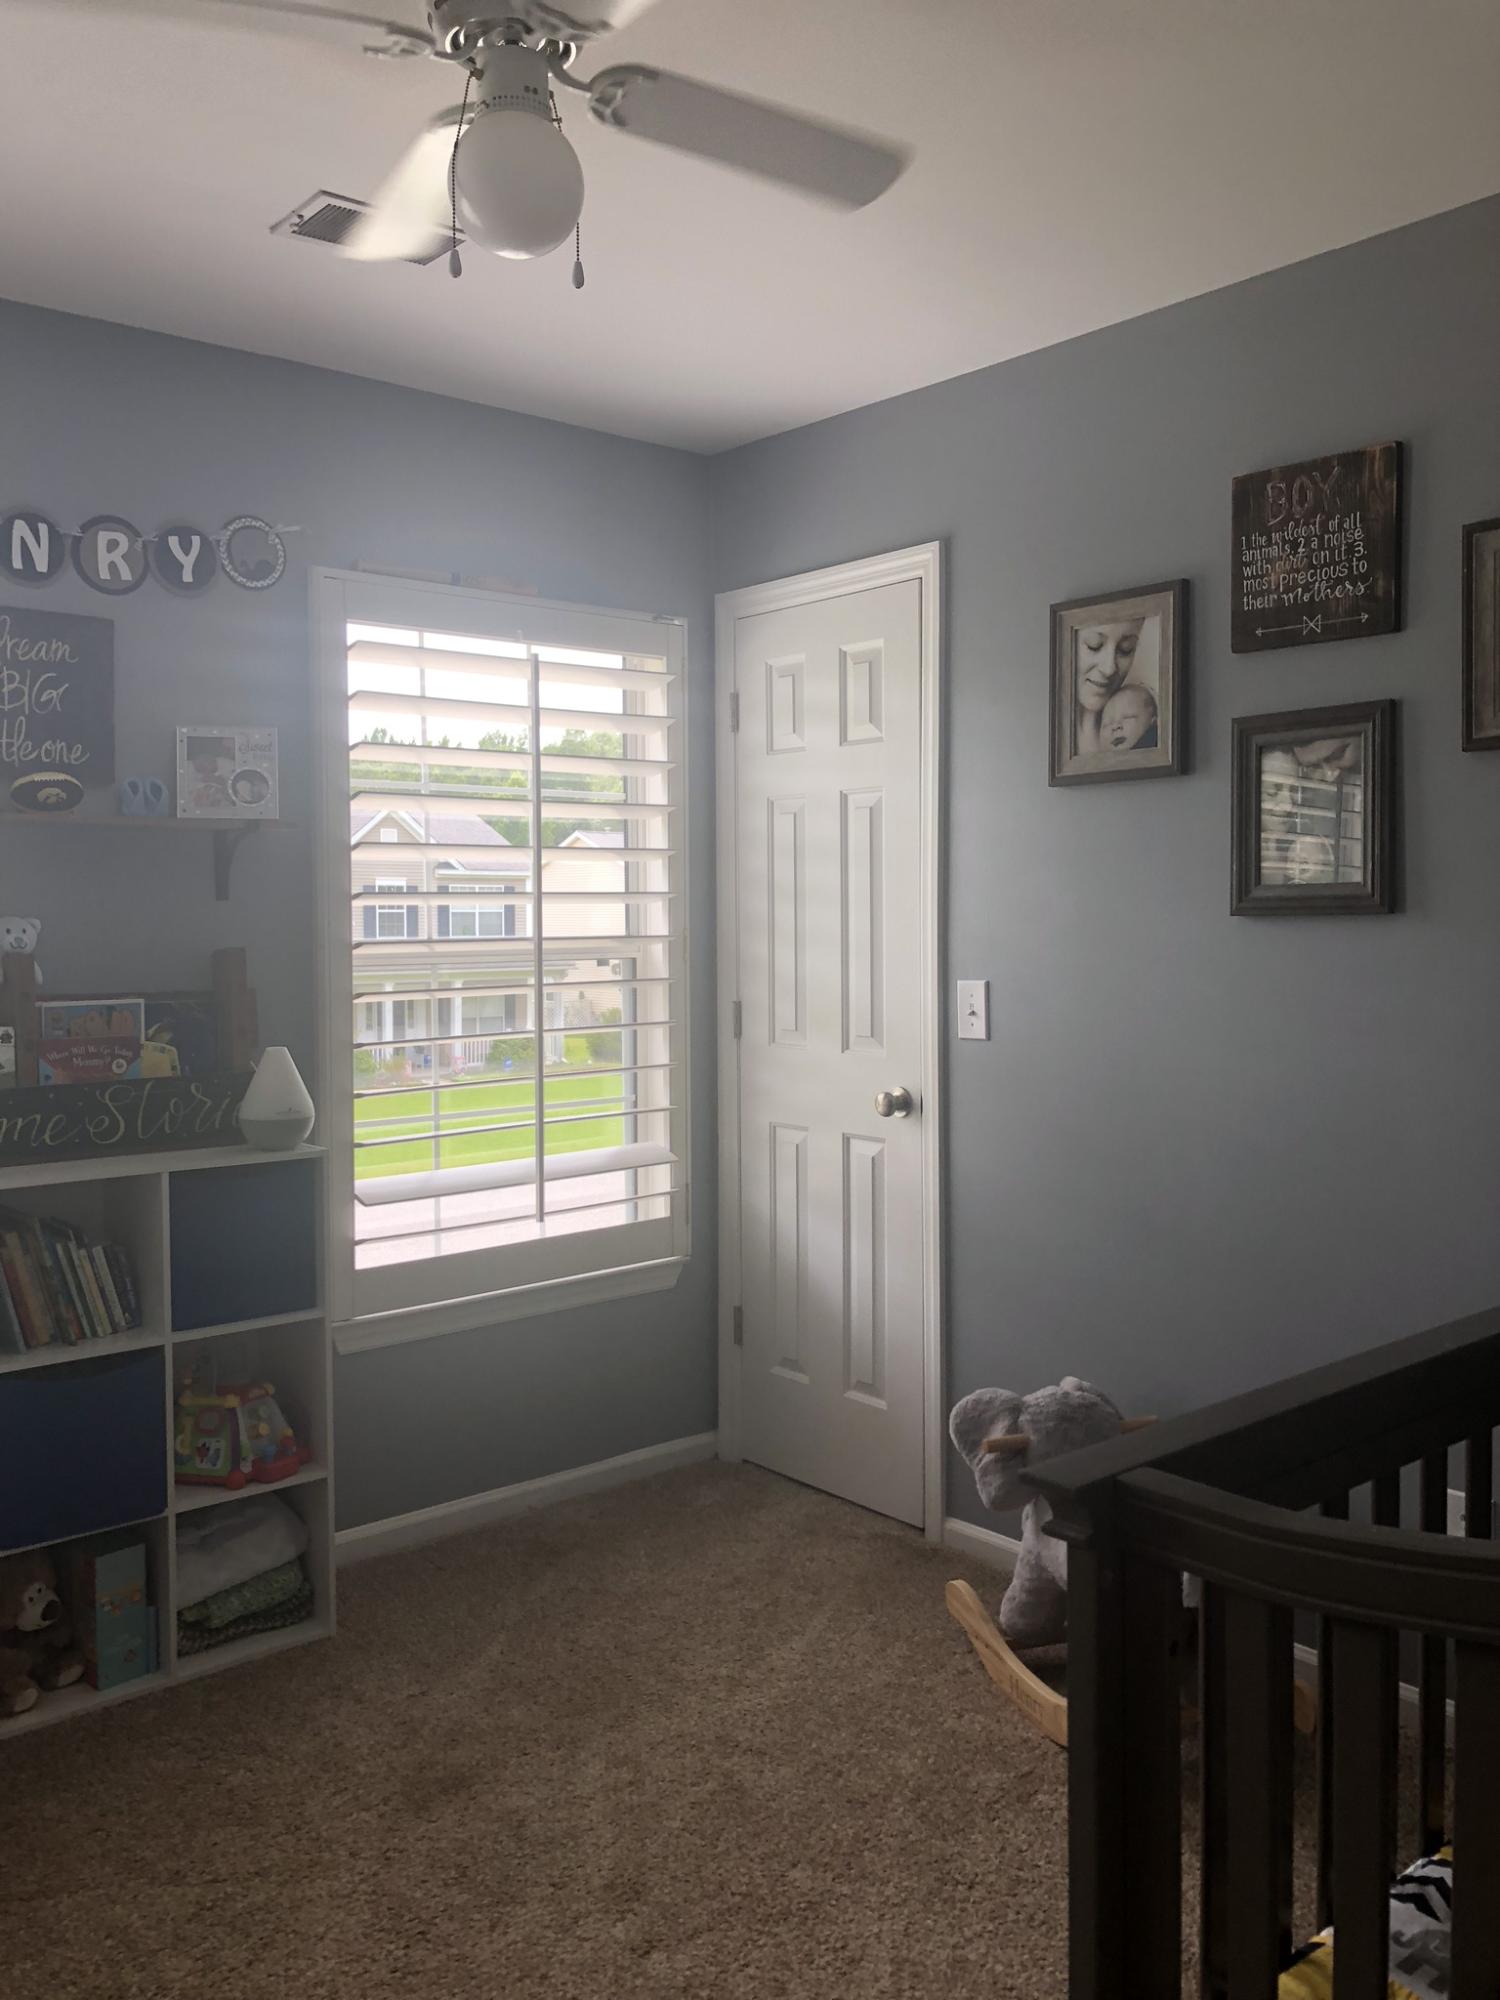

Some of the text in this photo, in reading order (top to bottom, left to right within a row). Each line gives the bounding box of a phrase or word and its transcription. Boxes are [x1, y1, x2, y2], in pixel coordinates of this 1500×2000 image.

[1266, 466, 1340, 526] BOY
[1242, 527, 1364, 562] animals. 2 a noise
[1252, 532, 1267, 548] the
[1272, 513, 1326, 543] wildest
[1329, 514, 1341, 532] of
[1344, 512, 1361, 529] all
[1243, 560, 1271, 577] with
[1312, 550, 1330, 564] on
[1243, 557, 1367, 593] most precious to
[1243, 593, 1278, 611] their
[0, 666, 69, 715] BIG
[86, 1080, 240, 1145] Stori
